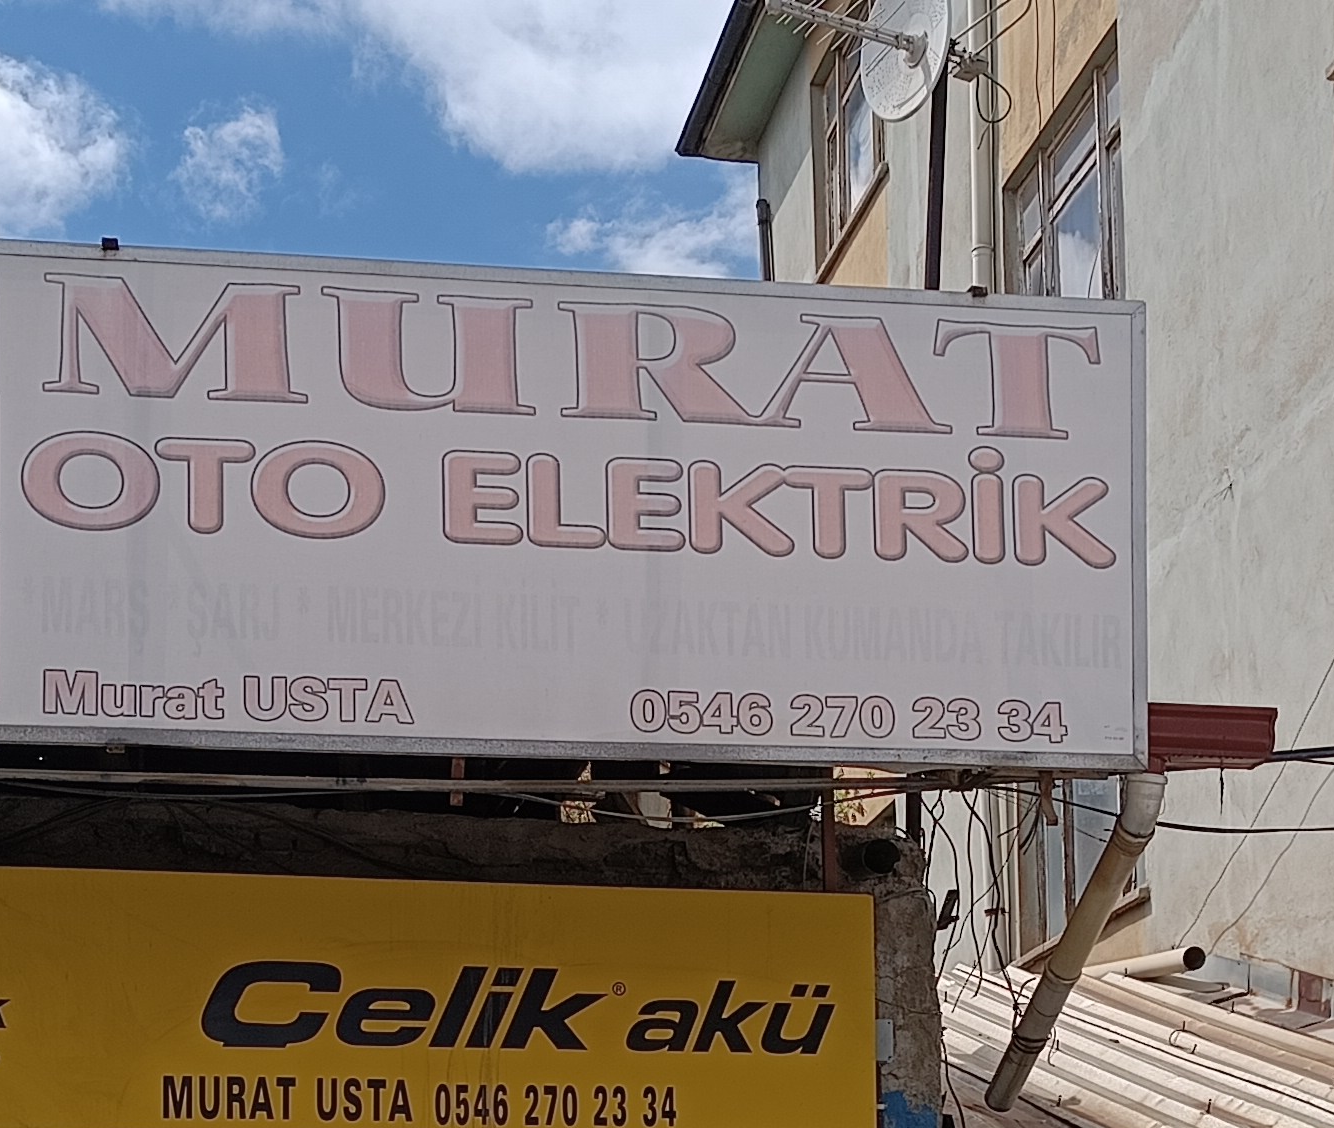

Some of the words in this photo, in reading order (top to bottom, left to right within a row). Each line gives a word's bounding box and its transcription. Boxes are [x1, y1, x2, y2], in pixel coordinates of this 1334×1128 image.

[43, 272, 1100, 440] MURAT
[21, 431, 386, 539] OTO
[442, 446, 1117, 569] ELEKTRİK
[42, 669, 226, 720] Murat
[243, 676, 415, 724] USTA
[630, 689, 773, 735] 0546
[790, 694, 895, 738] 270
[912, 697, 982, 741] 23
[998, 699, 1069, 743] 34
[625, 979, 839, 1055] akü
[162, 1074, 297, 1121] MURAT
[316, 1077, 413, 1124] USTA
[434, 1082, 507, 1127] 0546
[524, 1084, 579, 1127] 270
[593, 1085, 628, 1128] 23
[642, 1086, 677, 1128] 34
